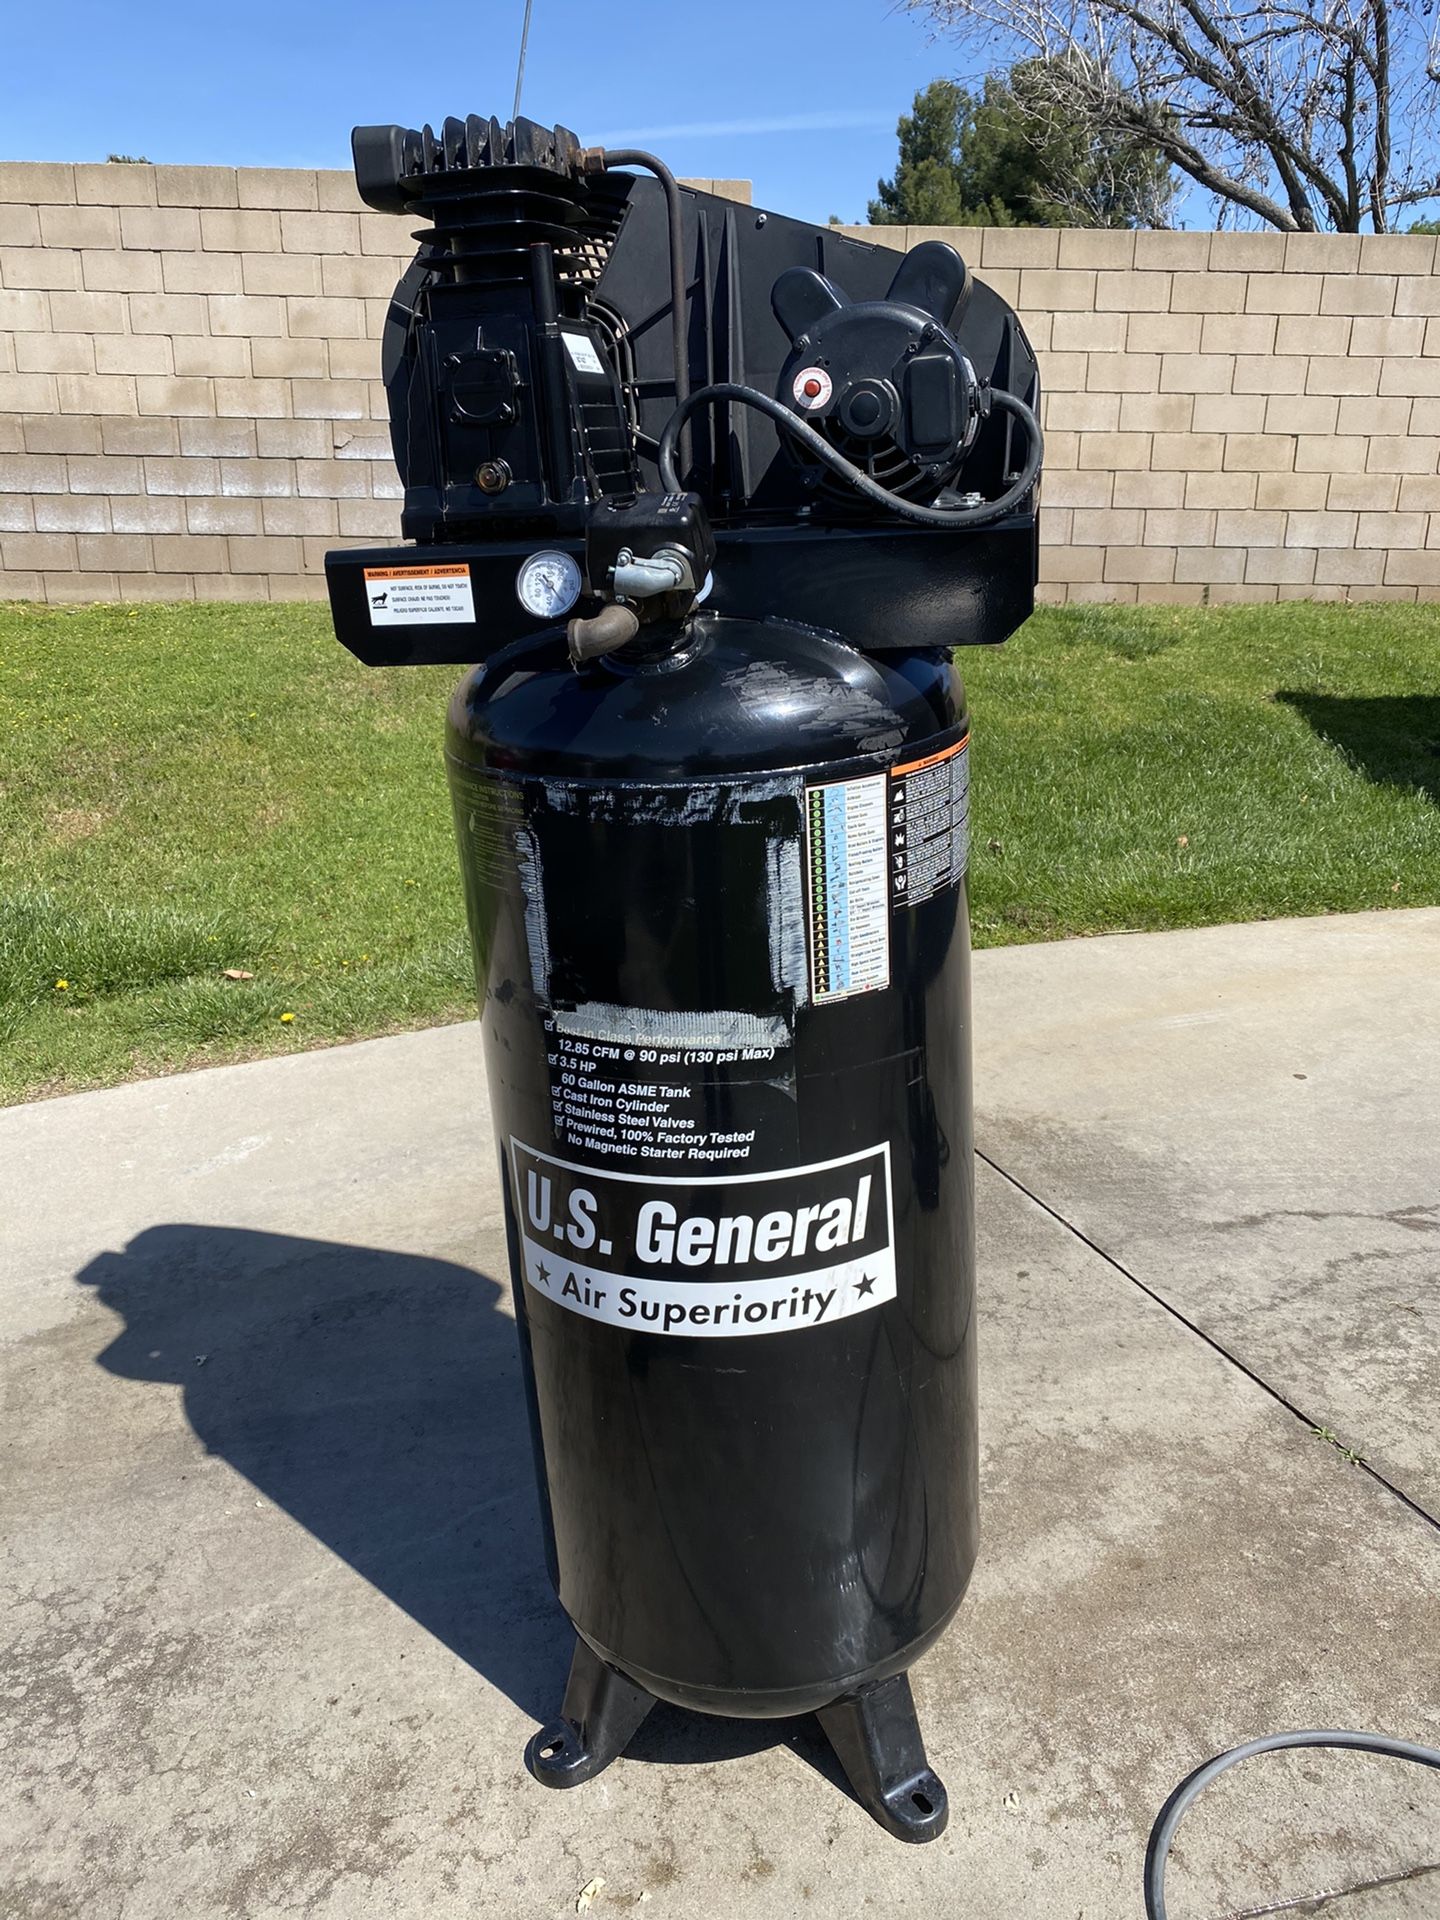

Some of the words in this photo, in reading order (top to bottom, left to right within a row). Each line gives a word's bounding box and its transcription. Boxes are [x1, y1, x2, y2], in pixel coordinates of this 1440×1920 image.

[598, 1030, 632, 1044] Class
[636, 1033, 720, 1046] Performance
[558, 1038, 590, 1055] 12.85
[592, 1046, 620, 1059] CFM
[624, 1049, 636, 1061] @
[639, 1050, 657, 1062] 90
[660, 1052, 681, 1065] psi
[684, 1051, 714, 1065] (130
[716, 1049, 738, 1065] psi
[742, 1046, 775, 1060] Max)
[560, 1056, 577, 1069] 3.5
[579, 1060, 597, 1072] HP
[561, 1072, 576, 1086] 60
[578, 1077, 615, 1093] Gallon
[618, 1084, 657, 1096] ASME
[659, 1086, 691, 1098] Tank
[563, 1089, 587, 1102] Cast
[590, 1094, 613, 1107] Iron
[616, 1098, 670, 1112] Cylinder
[564, 1103, 615, 1123] Stainless
[618, 1114, 649, 1127] Steel
[652, 1116, 695, 1129] Valves
[566, 1118, 617, 1139] Prewired,
[621, 1129, 654, 1142] 100%
[657, 1132, 707, 1146] Factory
[710, 1130, 755, 1143] Tested
[567, 1133, 582, 1146] No
[585, 1137, 638, 1156] Magnetic
[641, 1146, 685, 1159] Starter
[688, 1146, 750, 1161] Required
[527, 1169, 612, 1255] U.S.
[635, 1174, 872, 1266] General
[561, 1272, 606, 1308] Air
[618, 1288, 837, 1332] Superiority
